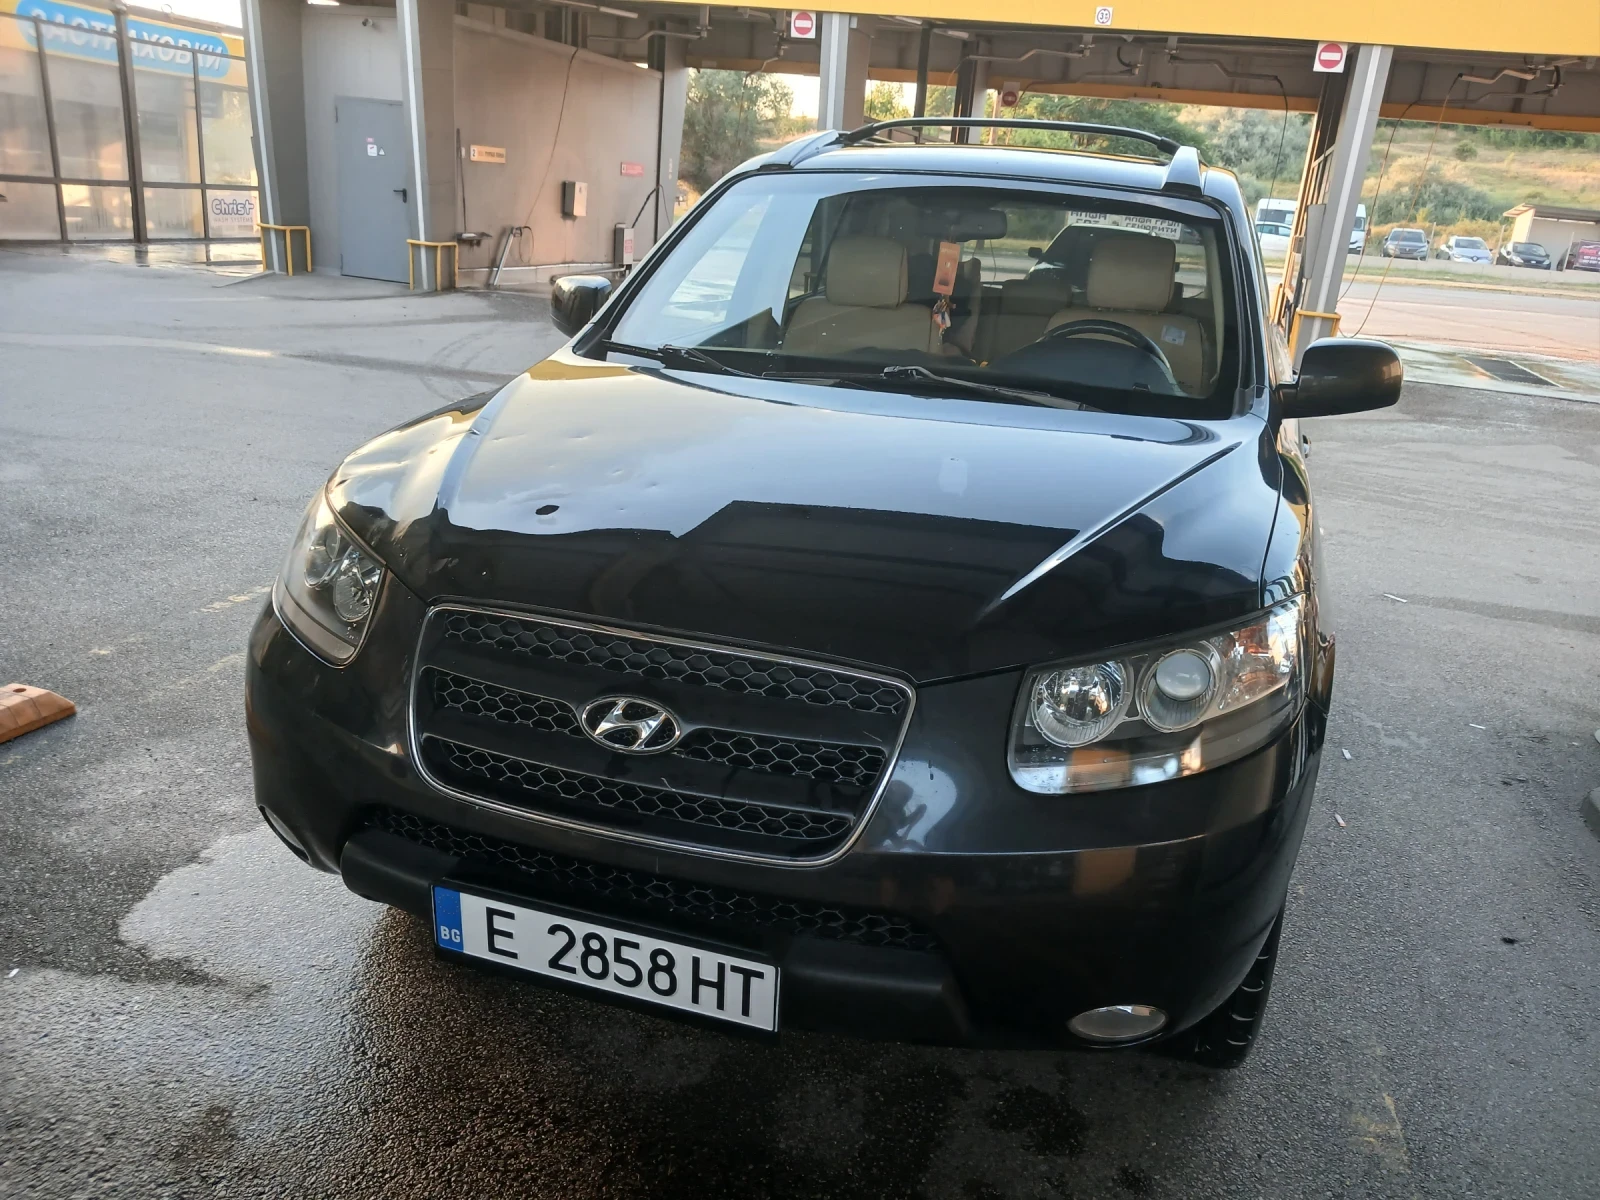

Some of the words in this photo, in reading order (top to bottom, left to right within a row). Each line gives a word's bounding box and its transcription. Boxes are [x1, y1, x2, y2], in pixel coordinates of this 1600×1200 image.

[211, 198, 255, 215] Christ
[440, 925, 461, 943] BG
[485, 906, 519, 960] E
[546, 923, 678, 997] 2858
[691, 955, 765, 1017] HT
